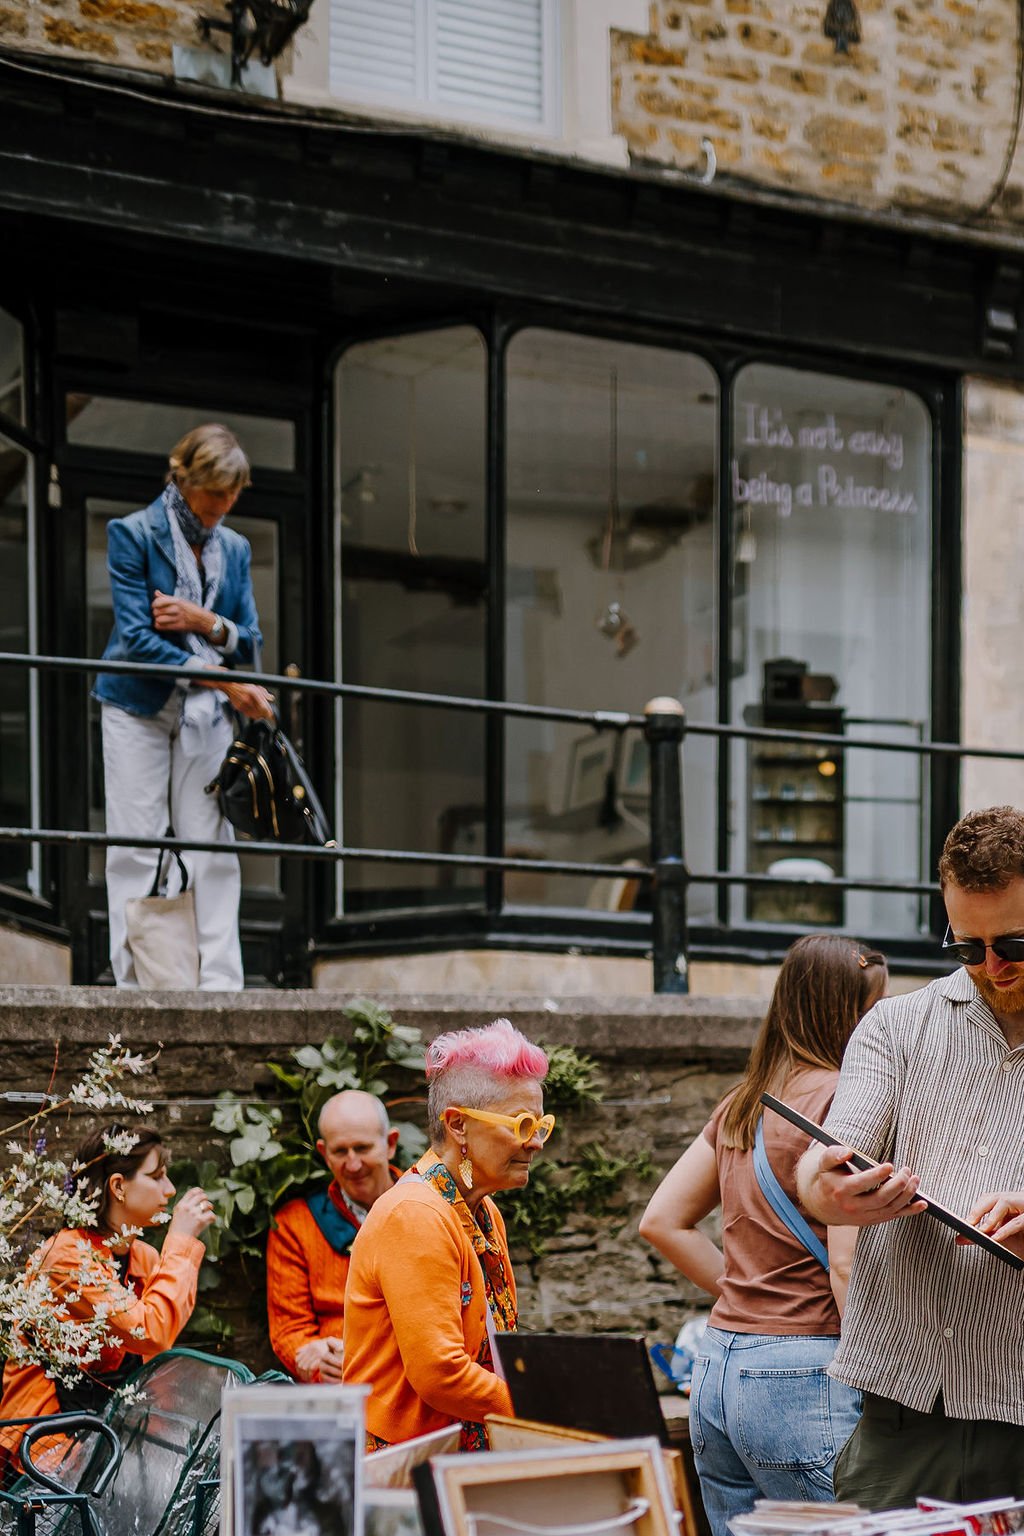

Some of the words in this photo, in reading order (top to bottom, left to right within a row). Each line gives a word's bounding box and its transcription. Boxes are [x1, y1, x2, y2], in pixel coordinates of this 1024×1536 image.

[797, 415, 844, 452] not
[848, 430, 904, 471] easy
[732, 459, 793, 517] being
[796, 482, 813, 506] a
